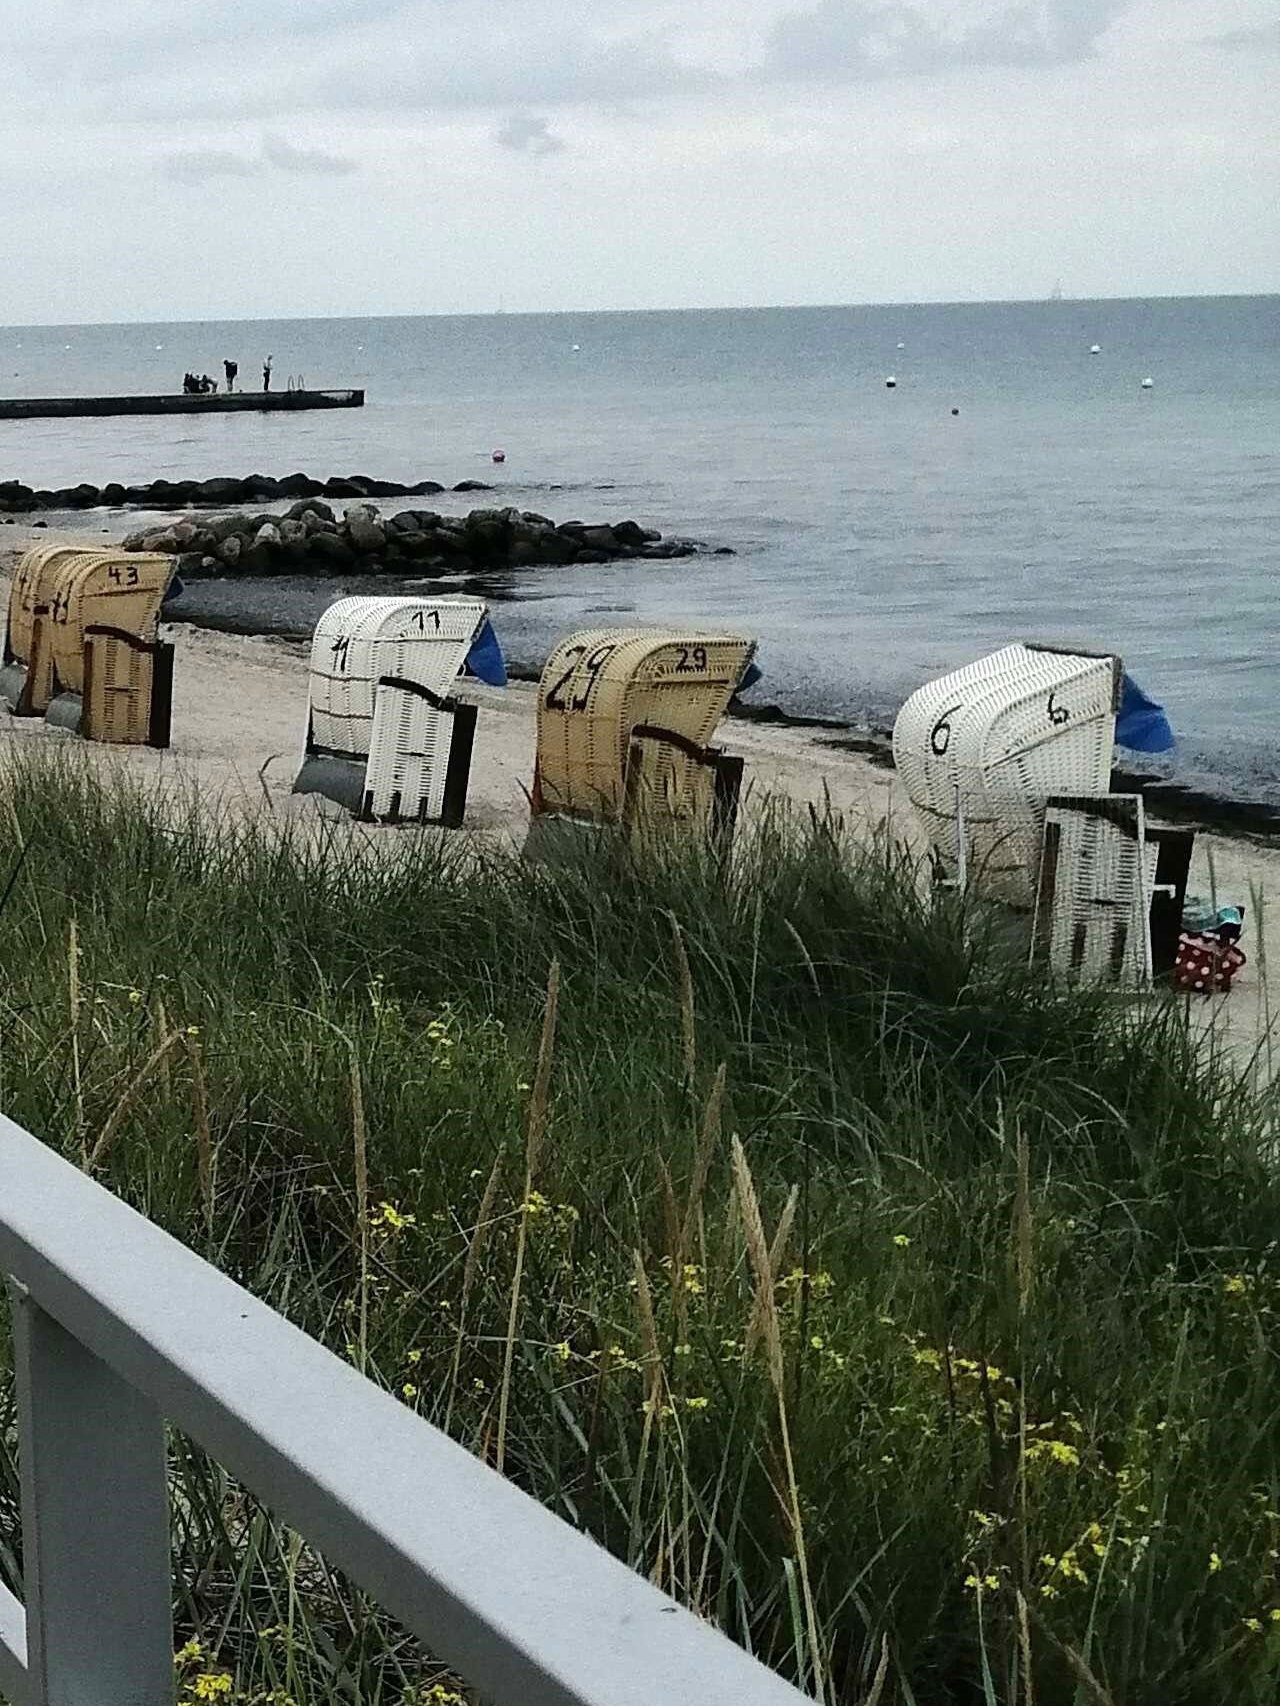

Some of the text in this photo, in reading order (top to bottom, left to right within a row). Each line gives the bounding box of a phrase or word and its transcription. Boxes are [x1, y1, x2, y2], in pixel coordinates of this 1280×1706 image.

[108, 565, 139, 586] 43
[411, 610, 441, 631] 11
[331, 634, 350, 673] 11
[675, 648, 707, 671] 29
[1047, 692, 1070, 725] 6
[930, 703, 965, 756] 6
